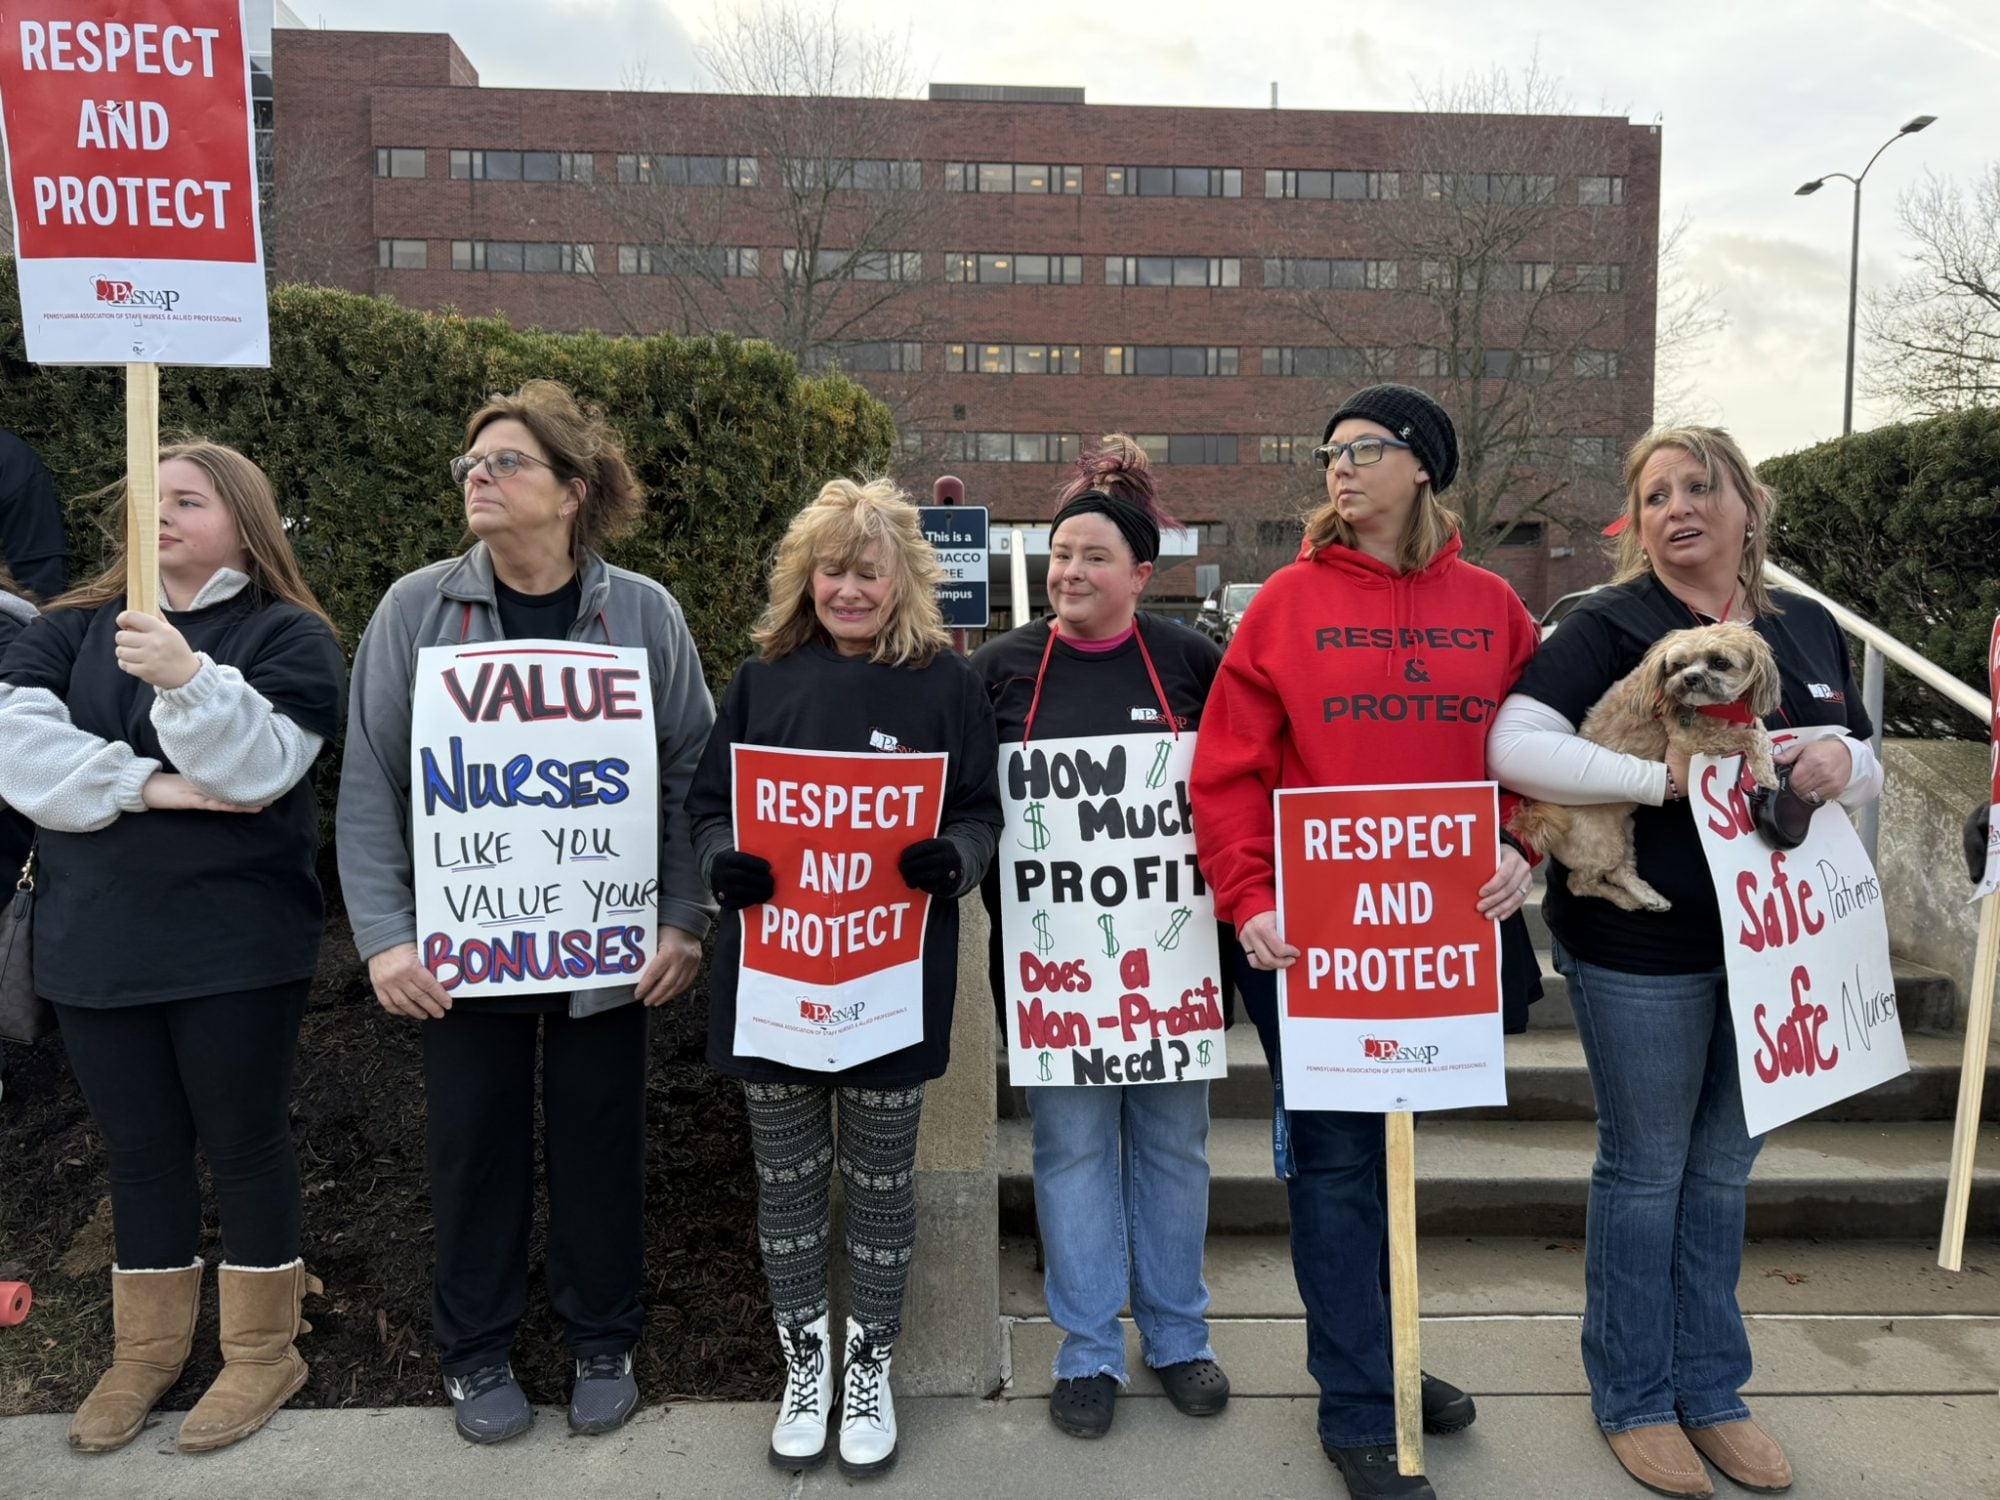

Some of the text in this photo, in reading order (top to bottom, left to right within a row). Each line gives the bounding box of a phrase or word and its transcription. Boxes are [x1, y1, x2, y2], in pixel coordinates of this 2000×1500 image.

[19, 20, 219, 77] RESPECT
[77, 99, 169, 150] AND
[33, 176, 231, 229] PROTECT
[80, 312, 114, 320] ASSOCIATION
[193, 314, 242, 323] PROFESSIONALS
[111, 282, 180, 311] PASNAP
[925, 531, 972, 542] This is a
[929, 552, 981, 563] BACCO
[934, 590, 973, 602] ampus
[941, 568, 964, 579] REE
[1315, 627, 1495, 652] RESPECT
[441, 662, 643, 723] VALUE
[1404, 659, 1431, 683] &
[1322, 694, 1497, 724] PROTECT
[1008, 744, 1127, 800] HOW
[756, 778, 924, 829] RESPECT
[434, 828, 620, 868] LIKE YOU
[1304, 814, 1477, 861] RESPECT
[799, 849, 872, 894] AND
[1014, 854, 1206, 907] PROFIT
[443, 878, 661, 923] VALUE YOUR
[1352, 881, 1434, 925] AND
[1737, 851, 1879, 953] Safe Patients
[761, 902, 911, 958] PROTECT
[423, 925, 646, 991] BONUSES
[1020, 948, 1150, 993] Does a
[1307, 943, 1480, 992] PROTECT
[812, 1001, 865, 1024] PASNAP
[1754, 965, 1839, 1084] Safe
[1306, 1065, 1345, 1073] PENNSYLVANIA
[1448, 1062, 1486, 1071] PROFESSIONALS
[1378, 1041, 1439, 1065] PASNAP
